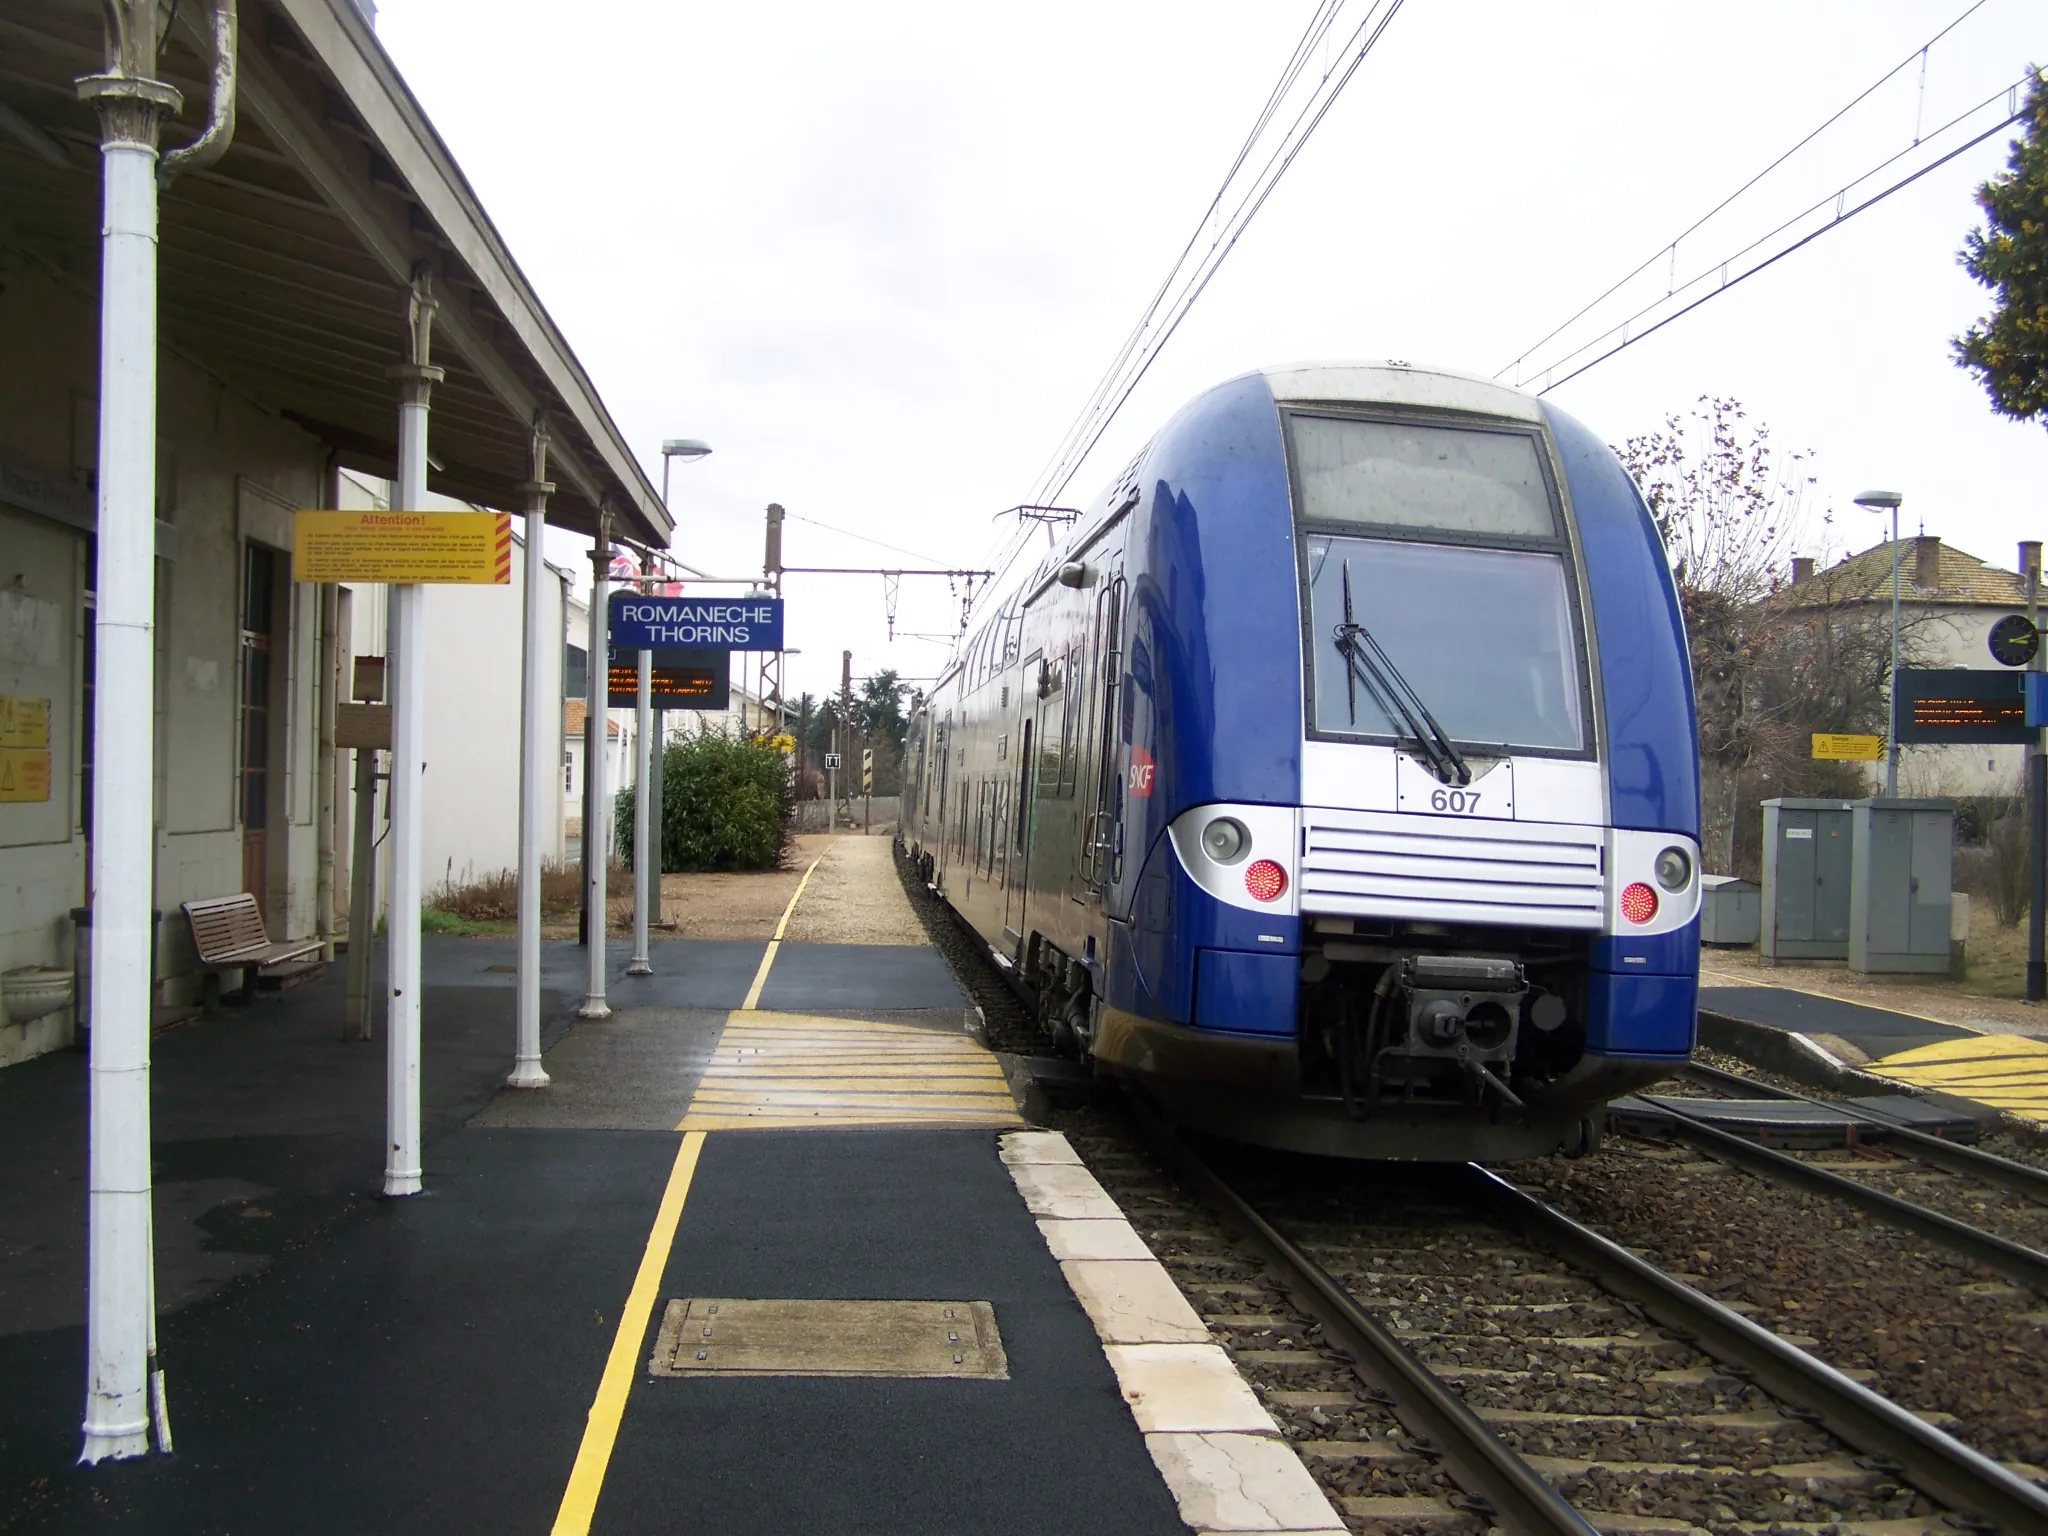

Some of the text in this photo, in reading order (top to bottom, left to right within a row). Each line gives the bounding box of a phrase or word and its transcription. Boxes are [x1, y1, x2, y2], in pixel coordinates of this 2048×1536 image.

[622, 605, 772, 624] ROMANECHE
[645, 626, 750, 643] THORINS
[1128, 764, 1154, 789] SNCF
[1431, 789, 1482, 813] 607
